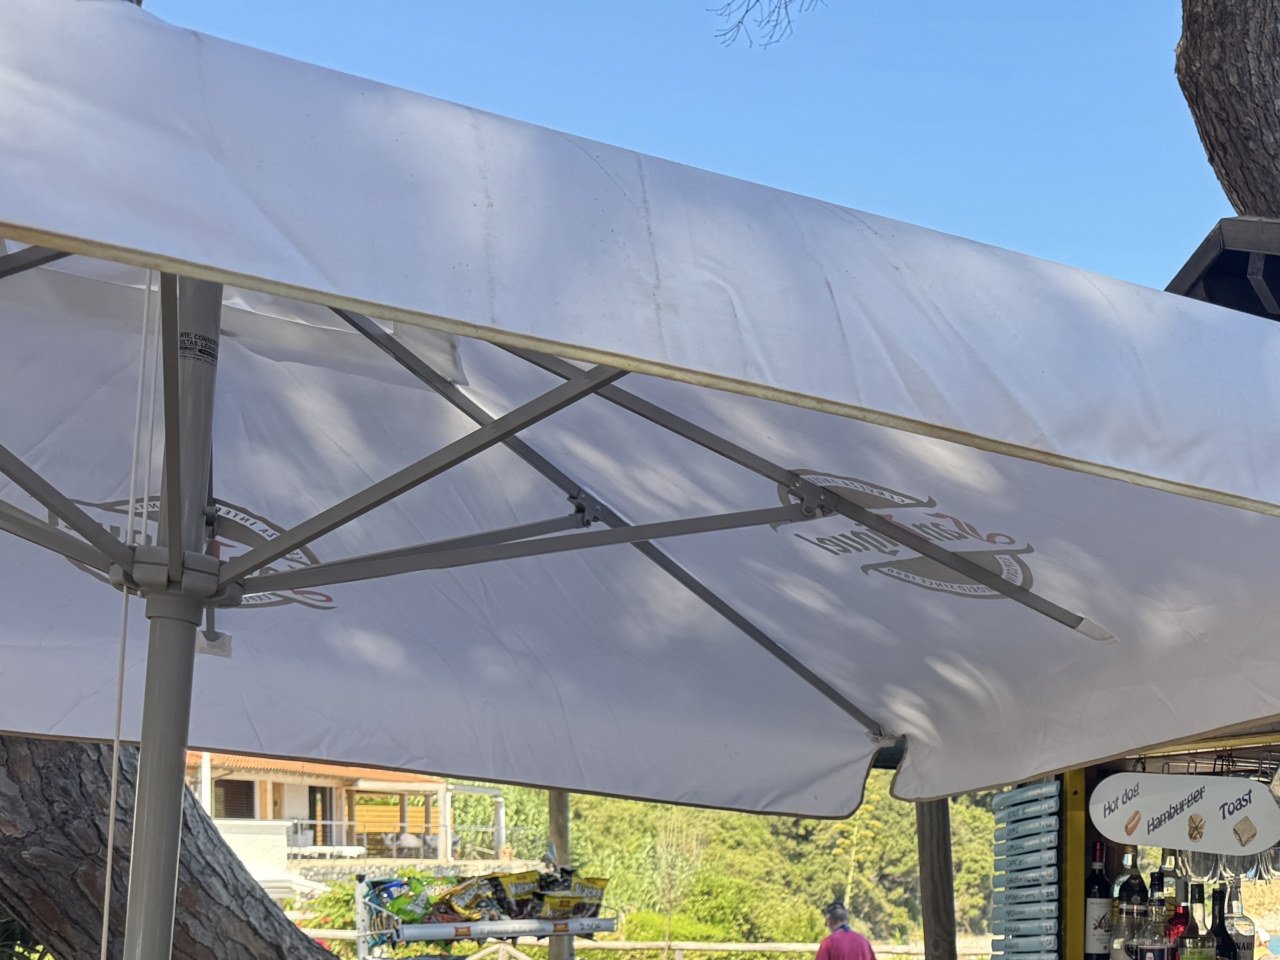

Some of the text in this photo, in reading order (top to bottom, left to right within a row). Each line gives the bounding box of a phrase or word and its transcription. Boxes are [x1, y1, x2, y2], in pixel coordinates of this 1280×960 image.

[1103, 782, 1140, 819] Hot dog
[1146, 785, 1206, 836] Hamburger
[1218, 789, 1253, 821] Toast
